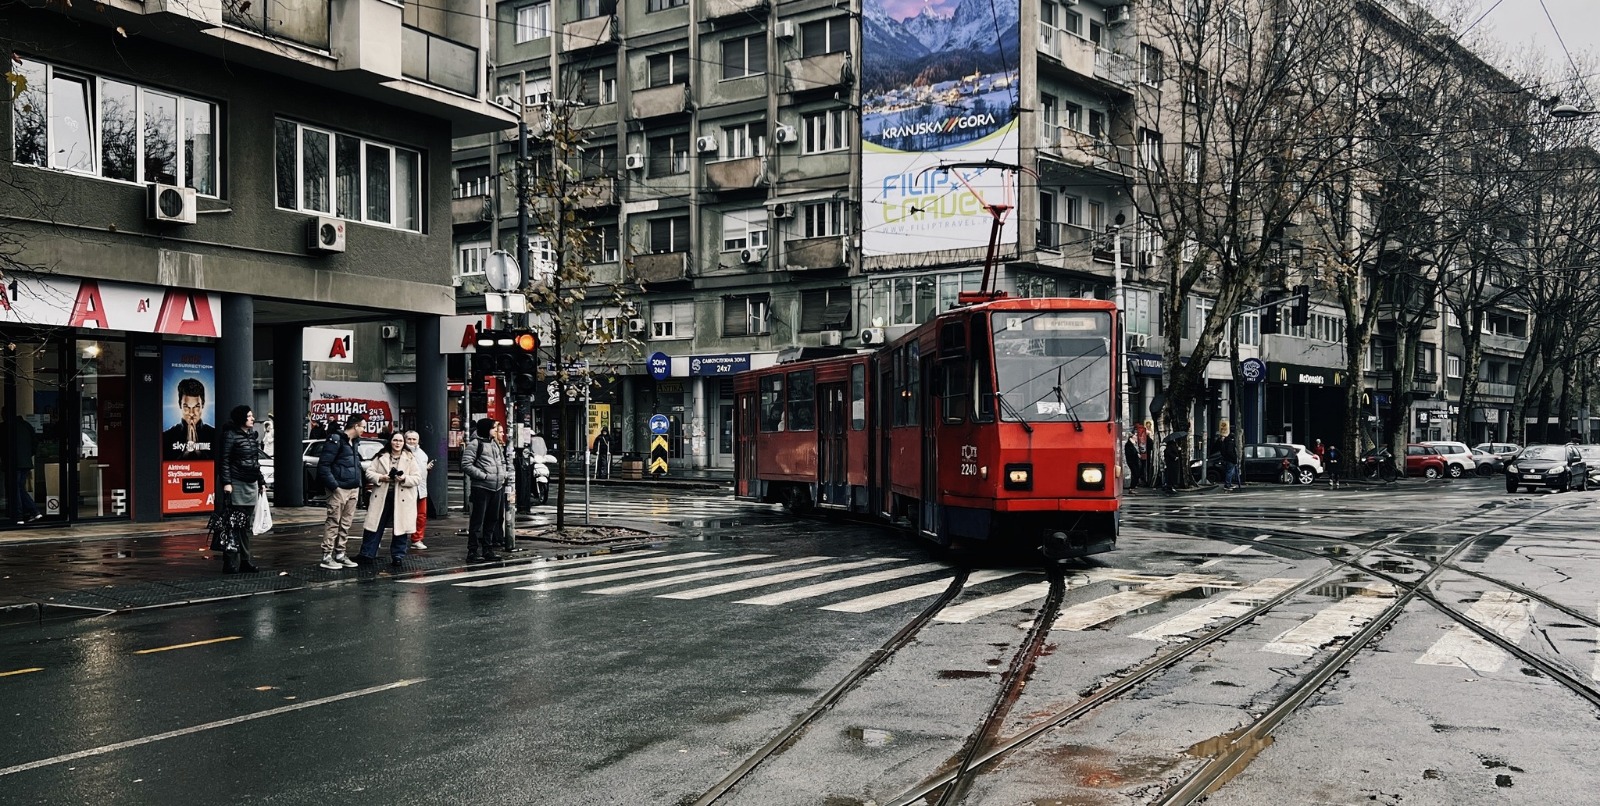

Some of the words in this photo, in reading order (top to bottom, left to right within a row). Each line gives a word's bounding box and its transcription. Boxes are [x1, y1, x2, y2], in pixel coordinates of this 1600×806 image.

[883, 121, 942, 139] KRANJSKA
[959, 113, 995, 128] GORA
[883, 168, 949, 198] FILIP
[137, 298, 149, 312] A1
[1011, 319, 1017, 328] 2
[329, 335, 350, 358] A1
[716, 364, 731, 373] 24x7
[1299, 373, 1324, 384] McDonald's
[961, 463, 978, 475] 2240
